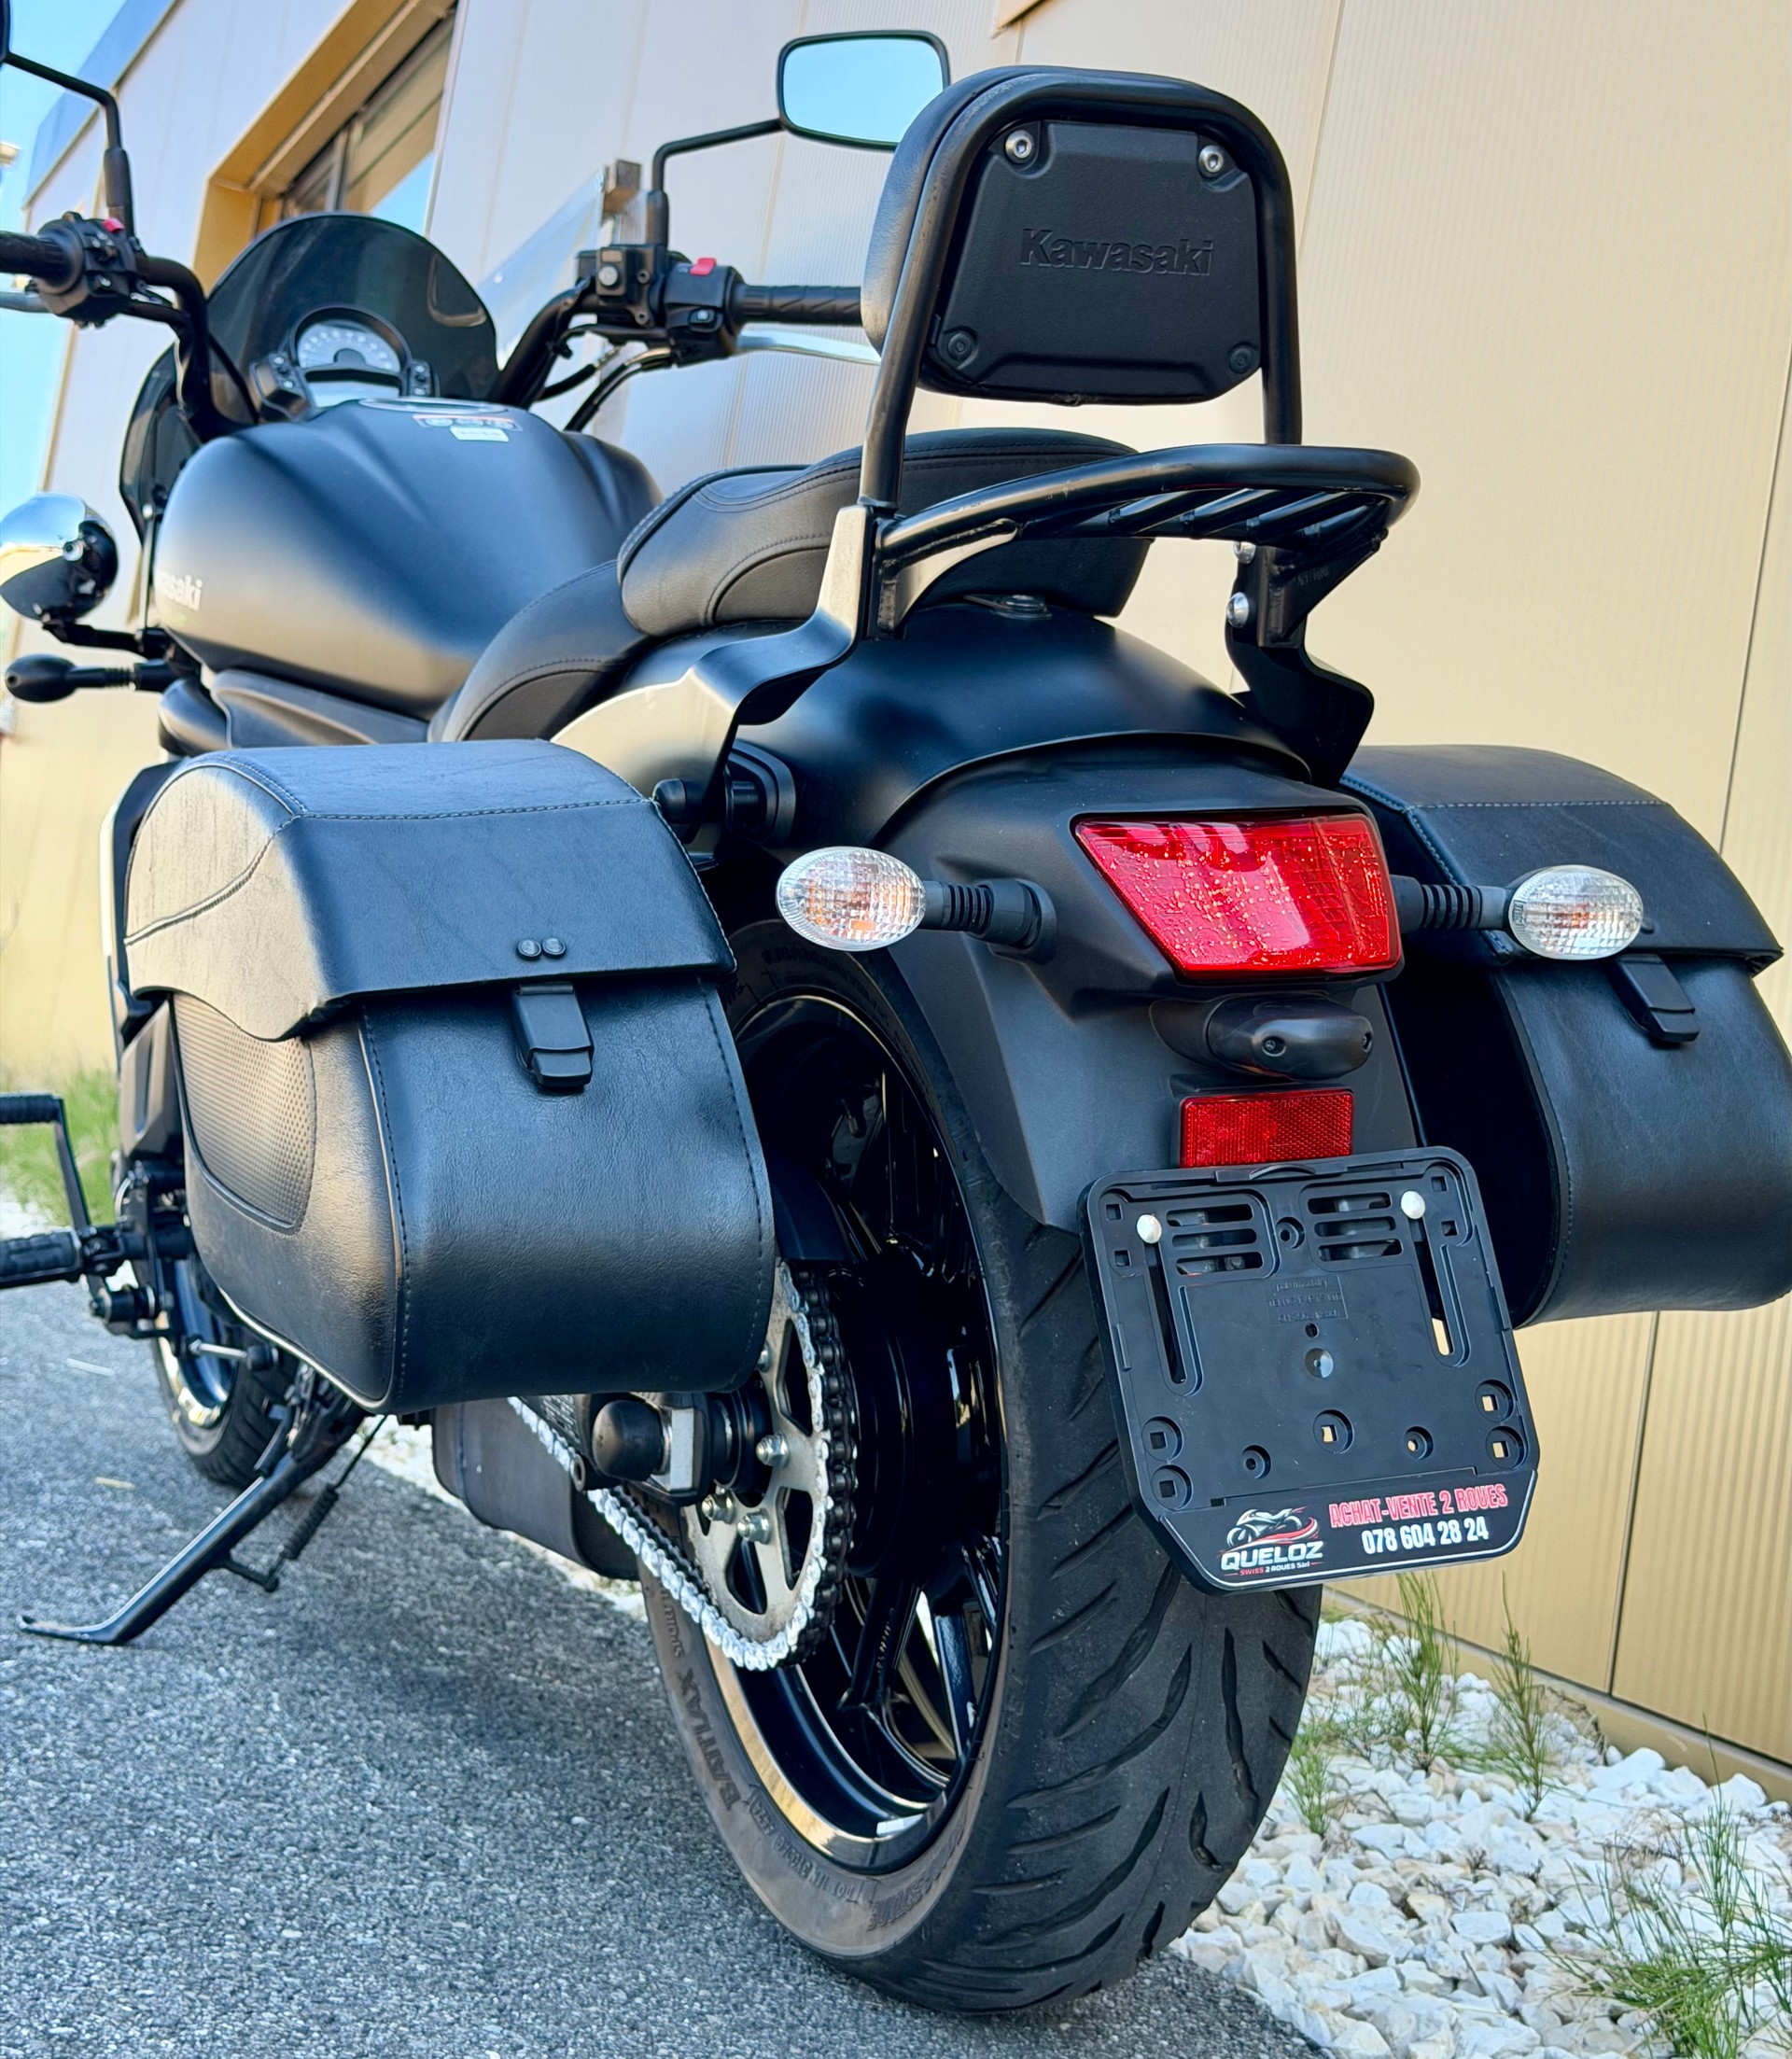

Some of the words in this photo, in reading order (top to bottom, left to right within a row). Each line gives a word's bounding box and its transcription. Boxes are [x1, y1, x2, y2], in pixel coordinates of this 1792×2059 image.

[1020, 228, 1213, 276] Kawasaki
[1329, 1492, 1438, 1528] ACHAT-VENTE
[1439, 1491, 1454, 1514] 2
[1454, 1483, 1508, 1512] ROUES
[1362, 1527, 1398, 1555] 078
[1400, 1522, 1436, 1550] 604
[1437, 1520, 1463, 1546] 28
[1463, 1516, 1490, 1542] 24
[1221, 1541, 1323, 1571] QUELOZ
[1239, 1567, 1264, 1576] SWISS
[1270, 1562, 1295, 1572] ROUES
